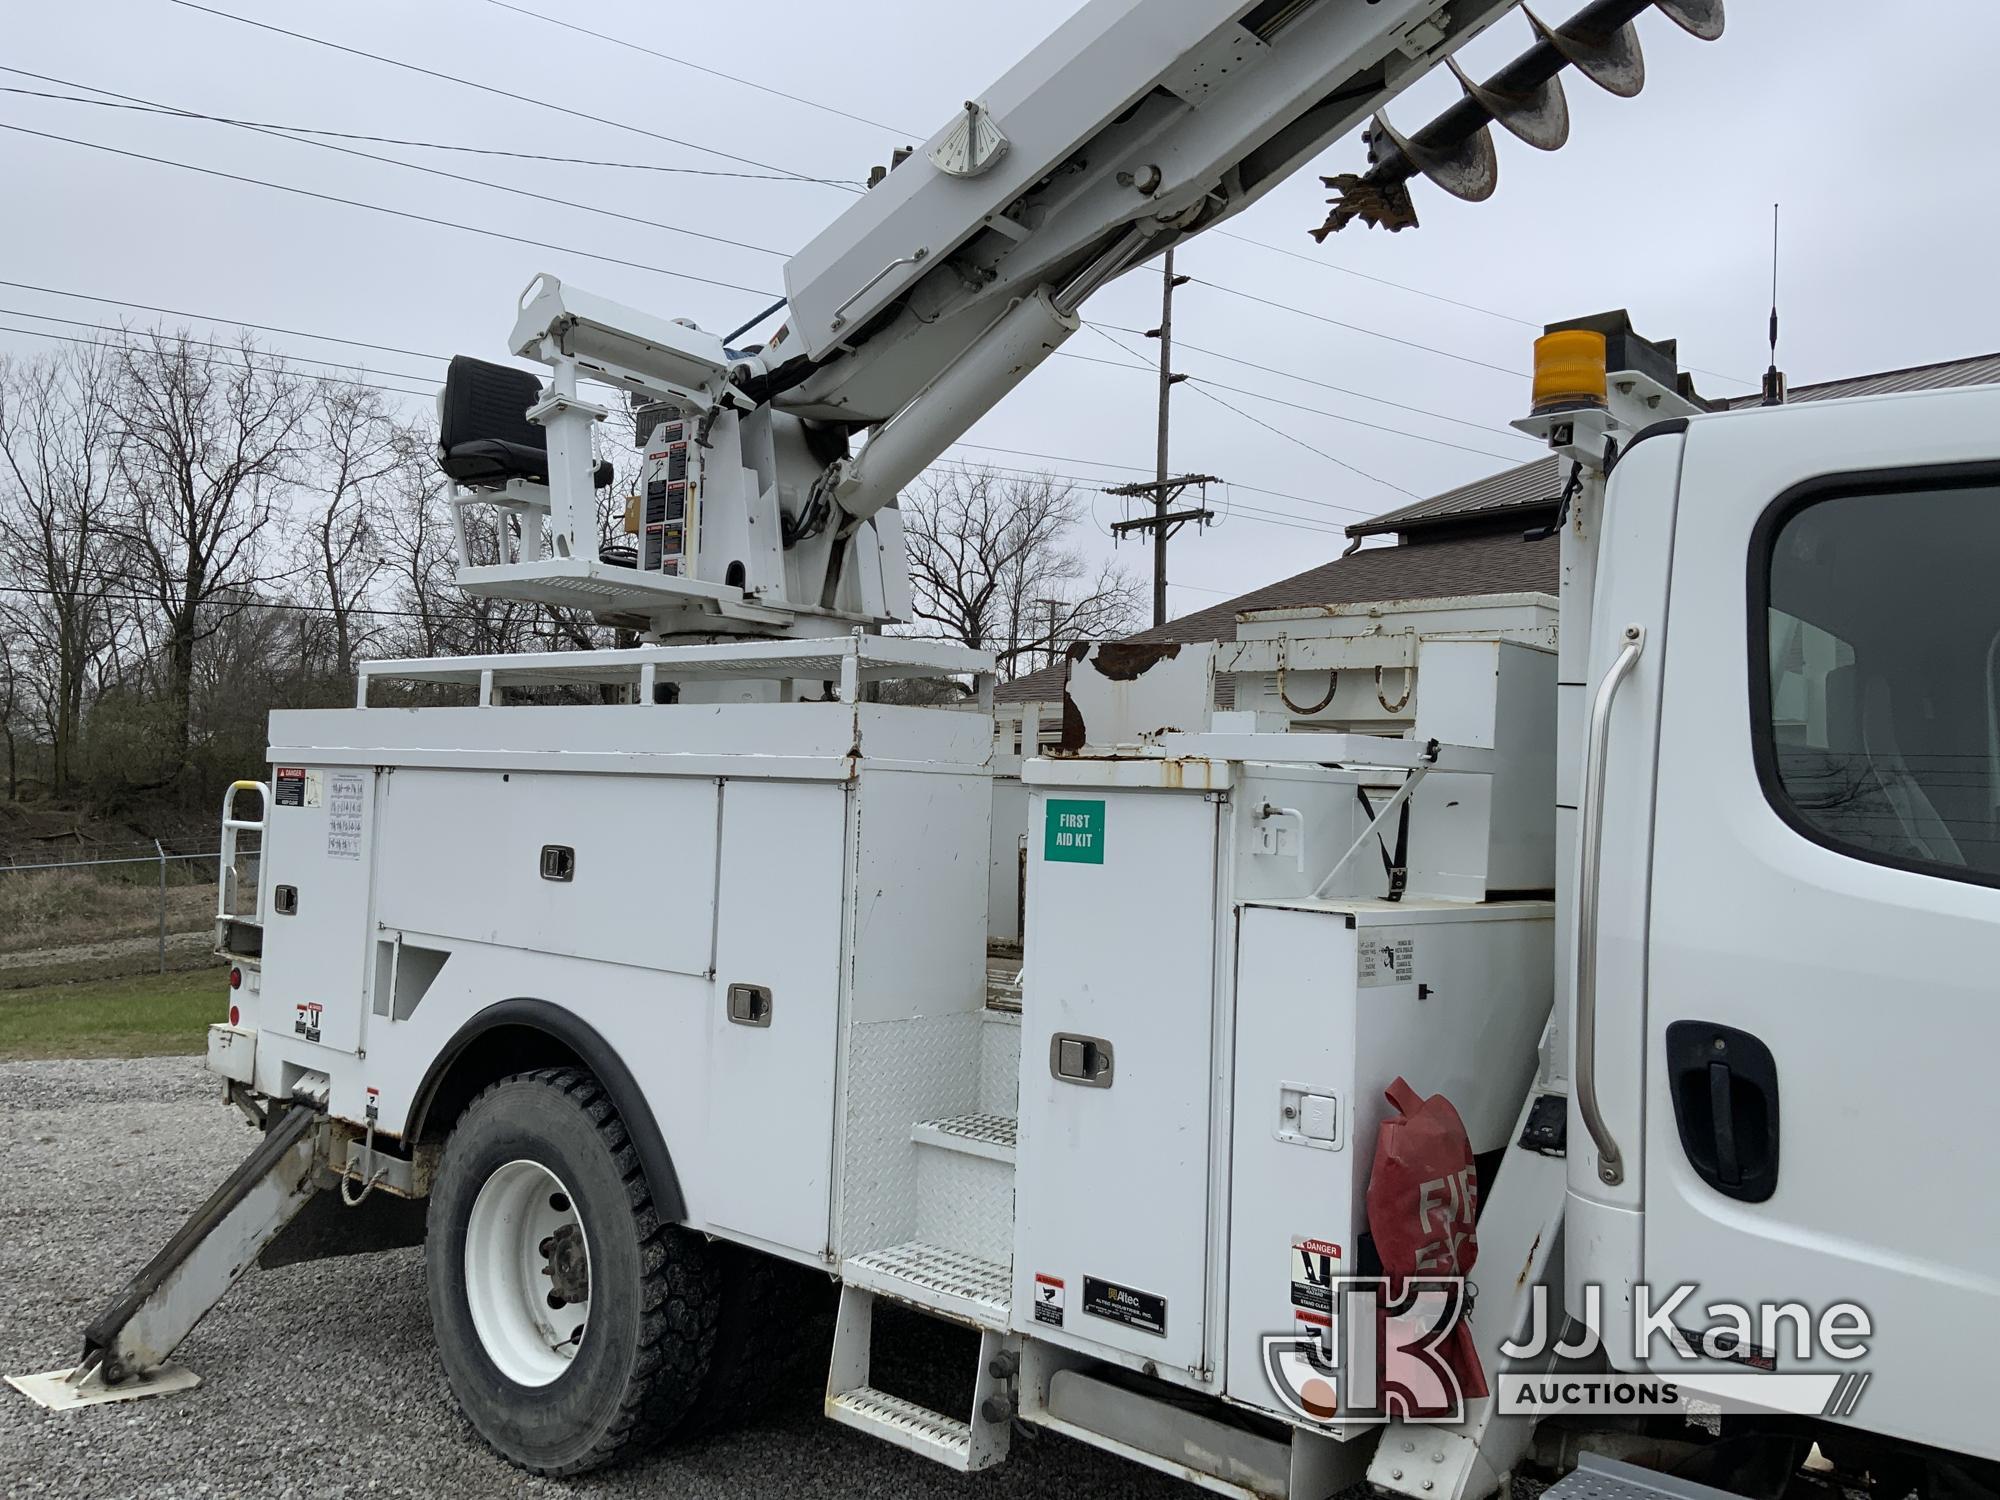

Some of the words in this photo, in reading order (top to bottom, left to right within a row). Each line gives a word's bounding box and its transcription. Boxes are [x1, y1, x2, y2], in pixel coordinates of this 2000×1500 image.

[285, 769, 302, 777] DANGER
[1060, 813, 1090, 828] FIRST
[1056, 832, 1073, 847] AID
[1075, 833, 1093, 848] KIT
[1306, 1241, 1337, 1255] DANGER
[1096, 1298, 1111, 1307] ALTEC
[1117, 1290, 1139, 1307] Altec
[1300, 1298, 1315, 1307] STAND
[1315, 1302, 1331, 1310] CLEAR
